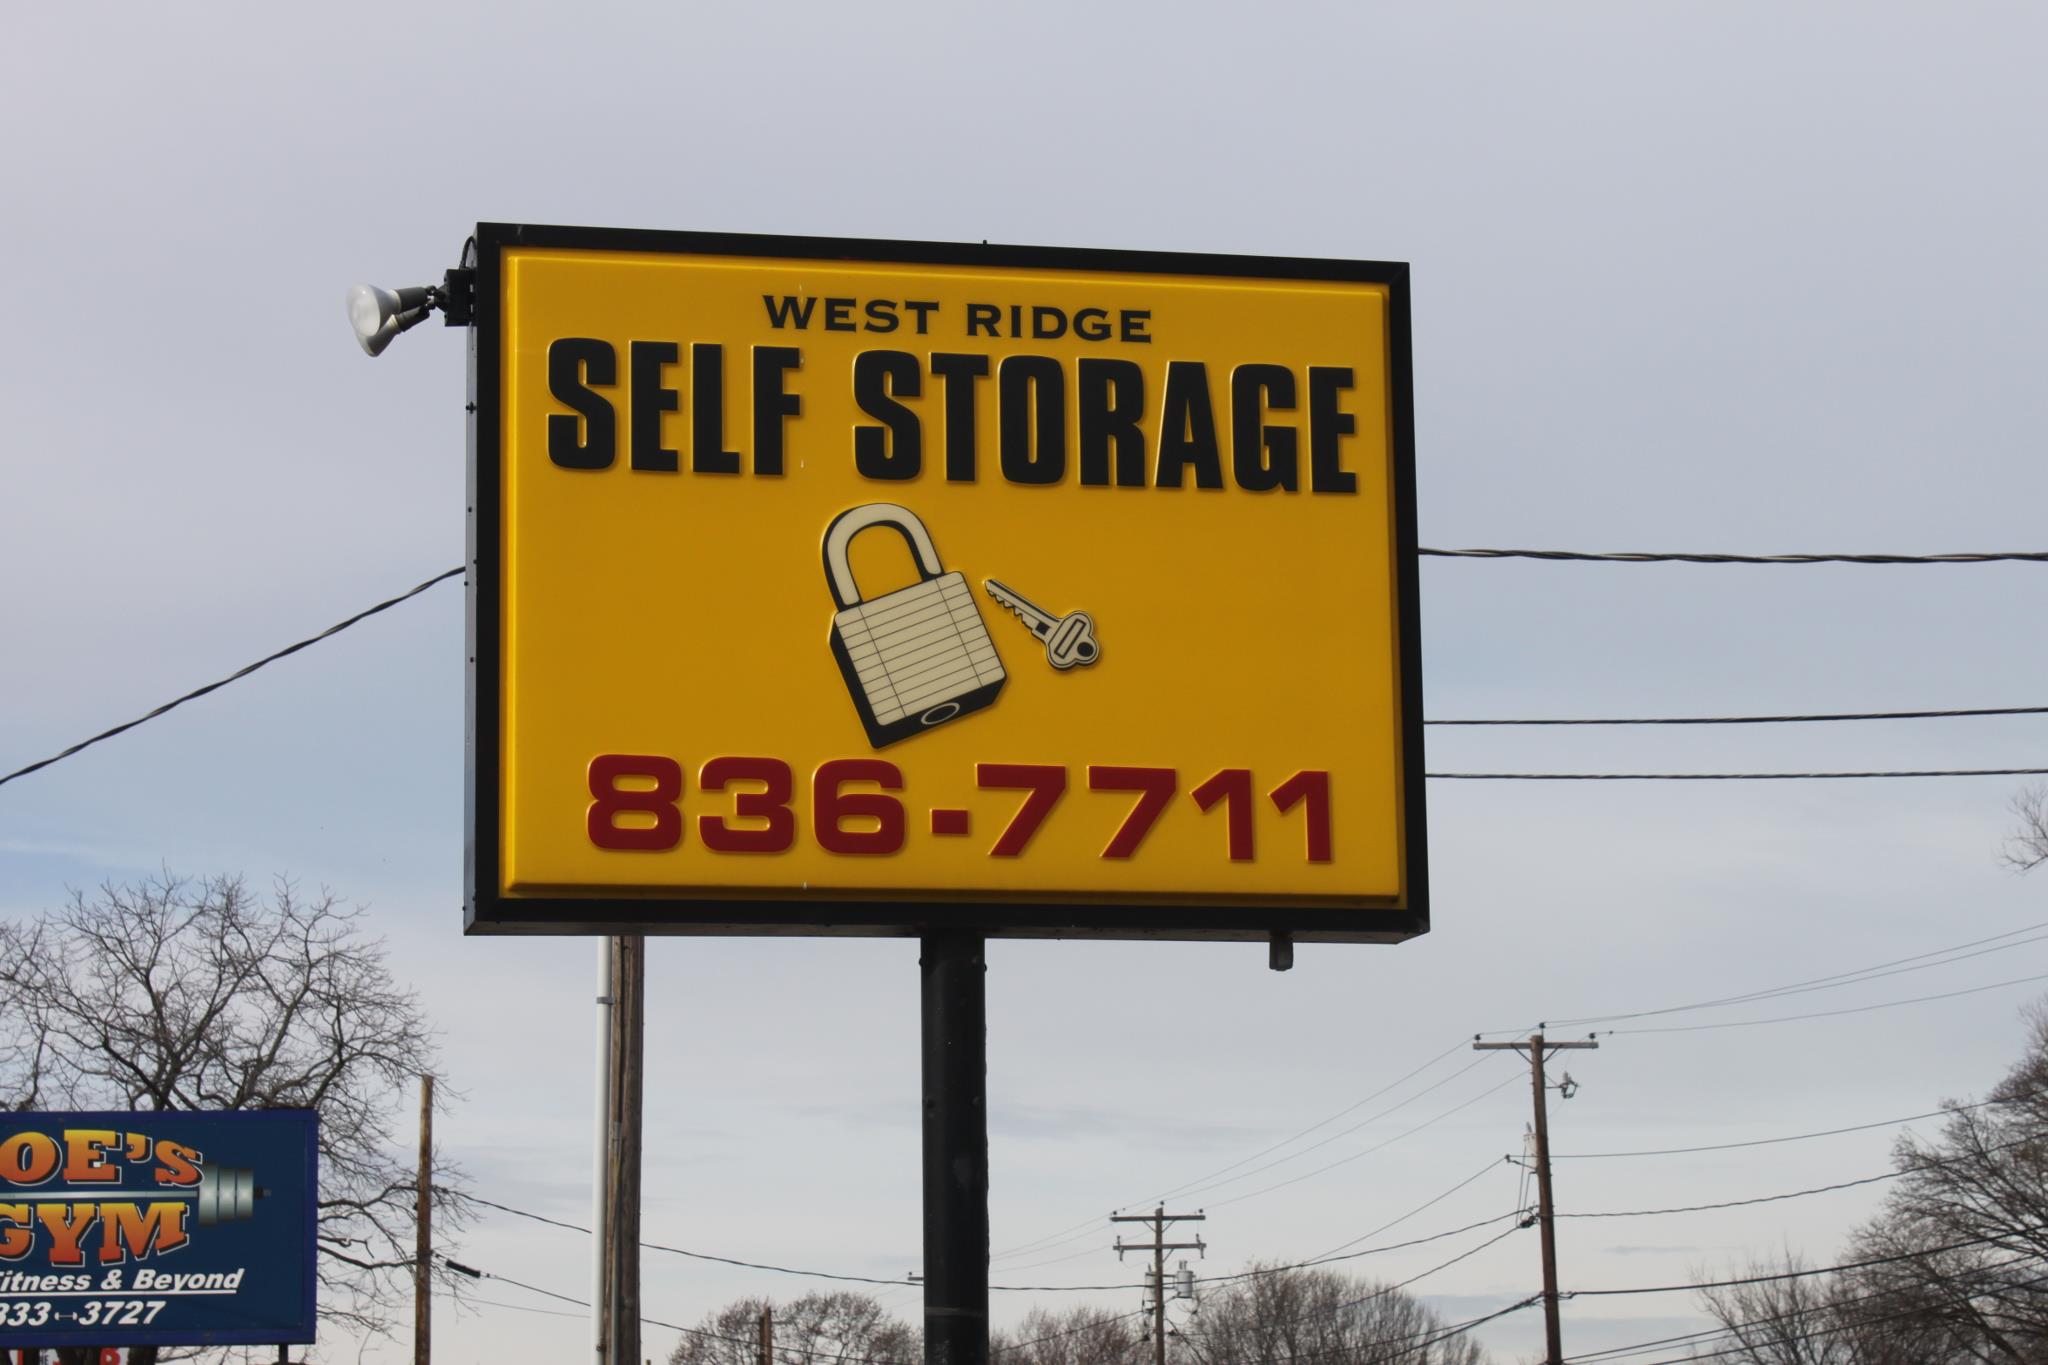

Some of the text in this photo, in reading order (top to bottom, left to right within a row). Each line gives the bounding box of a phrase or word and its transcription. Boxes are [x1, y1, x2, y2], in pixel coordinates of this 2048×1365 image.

[763, 296, 1152, 343] WEST RIDGE
[548, 337, 1358, 494] SELF STORAGE
[587, 754, 1332, 863] 836-7711
[0, 1202, 190, 1267] GYM
[0, 1268, 245, 1292] itness & Beyond
